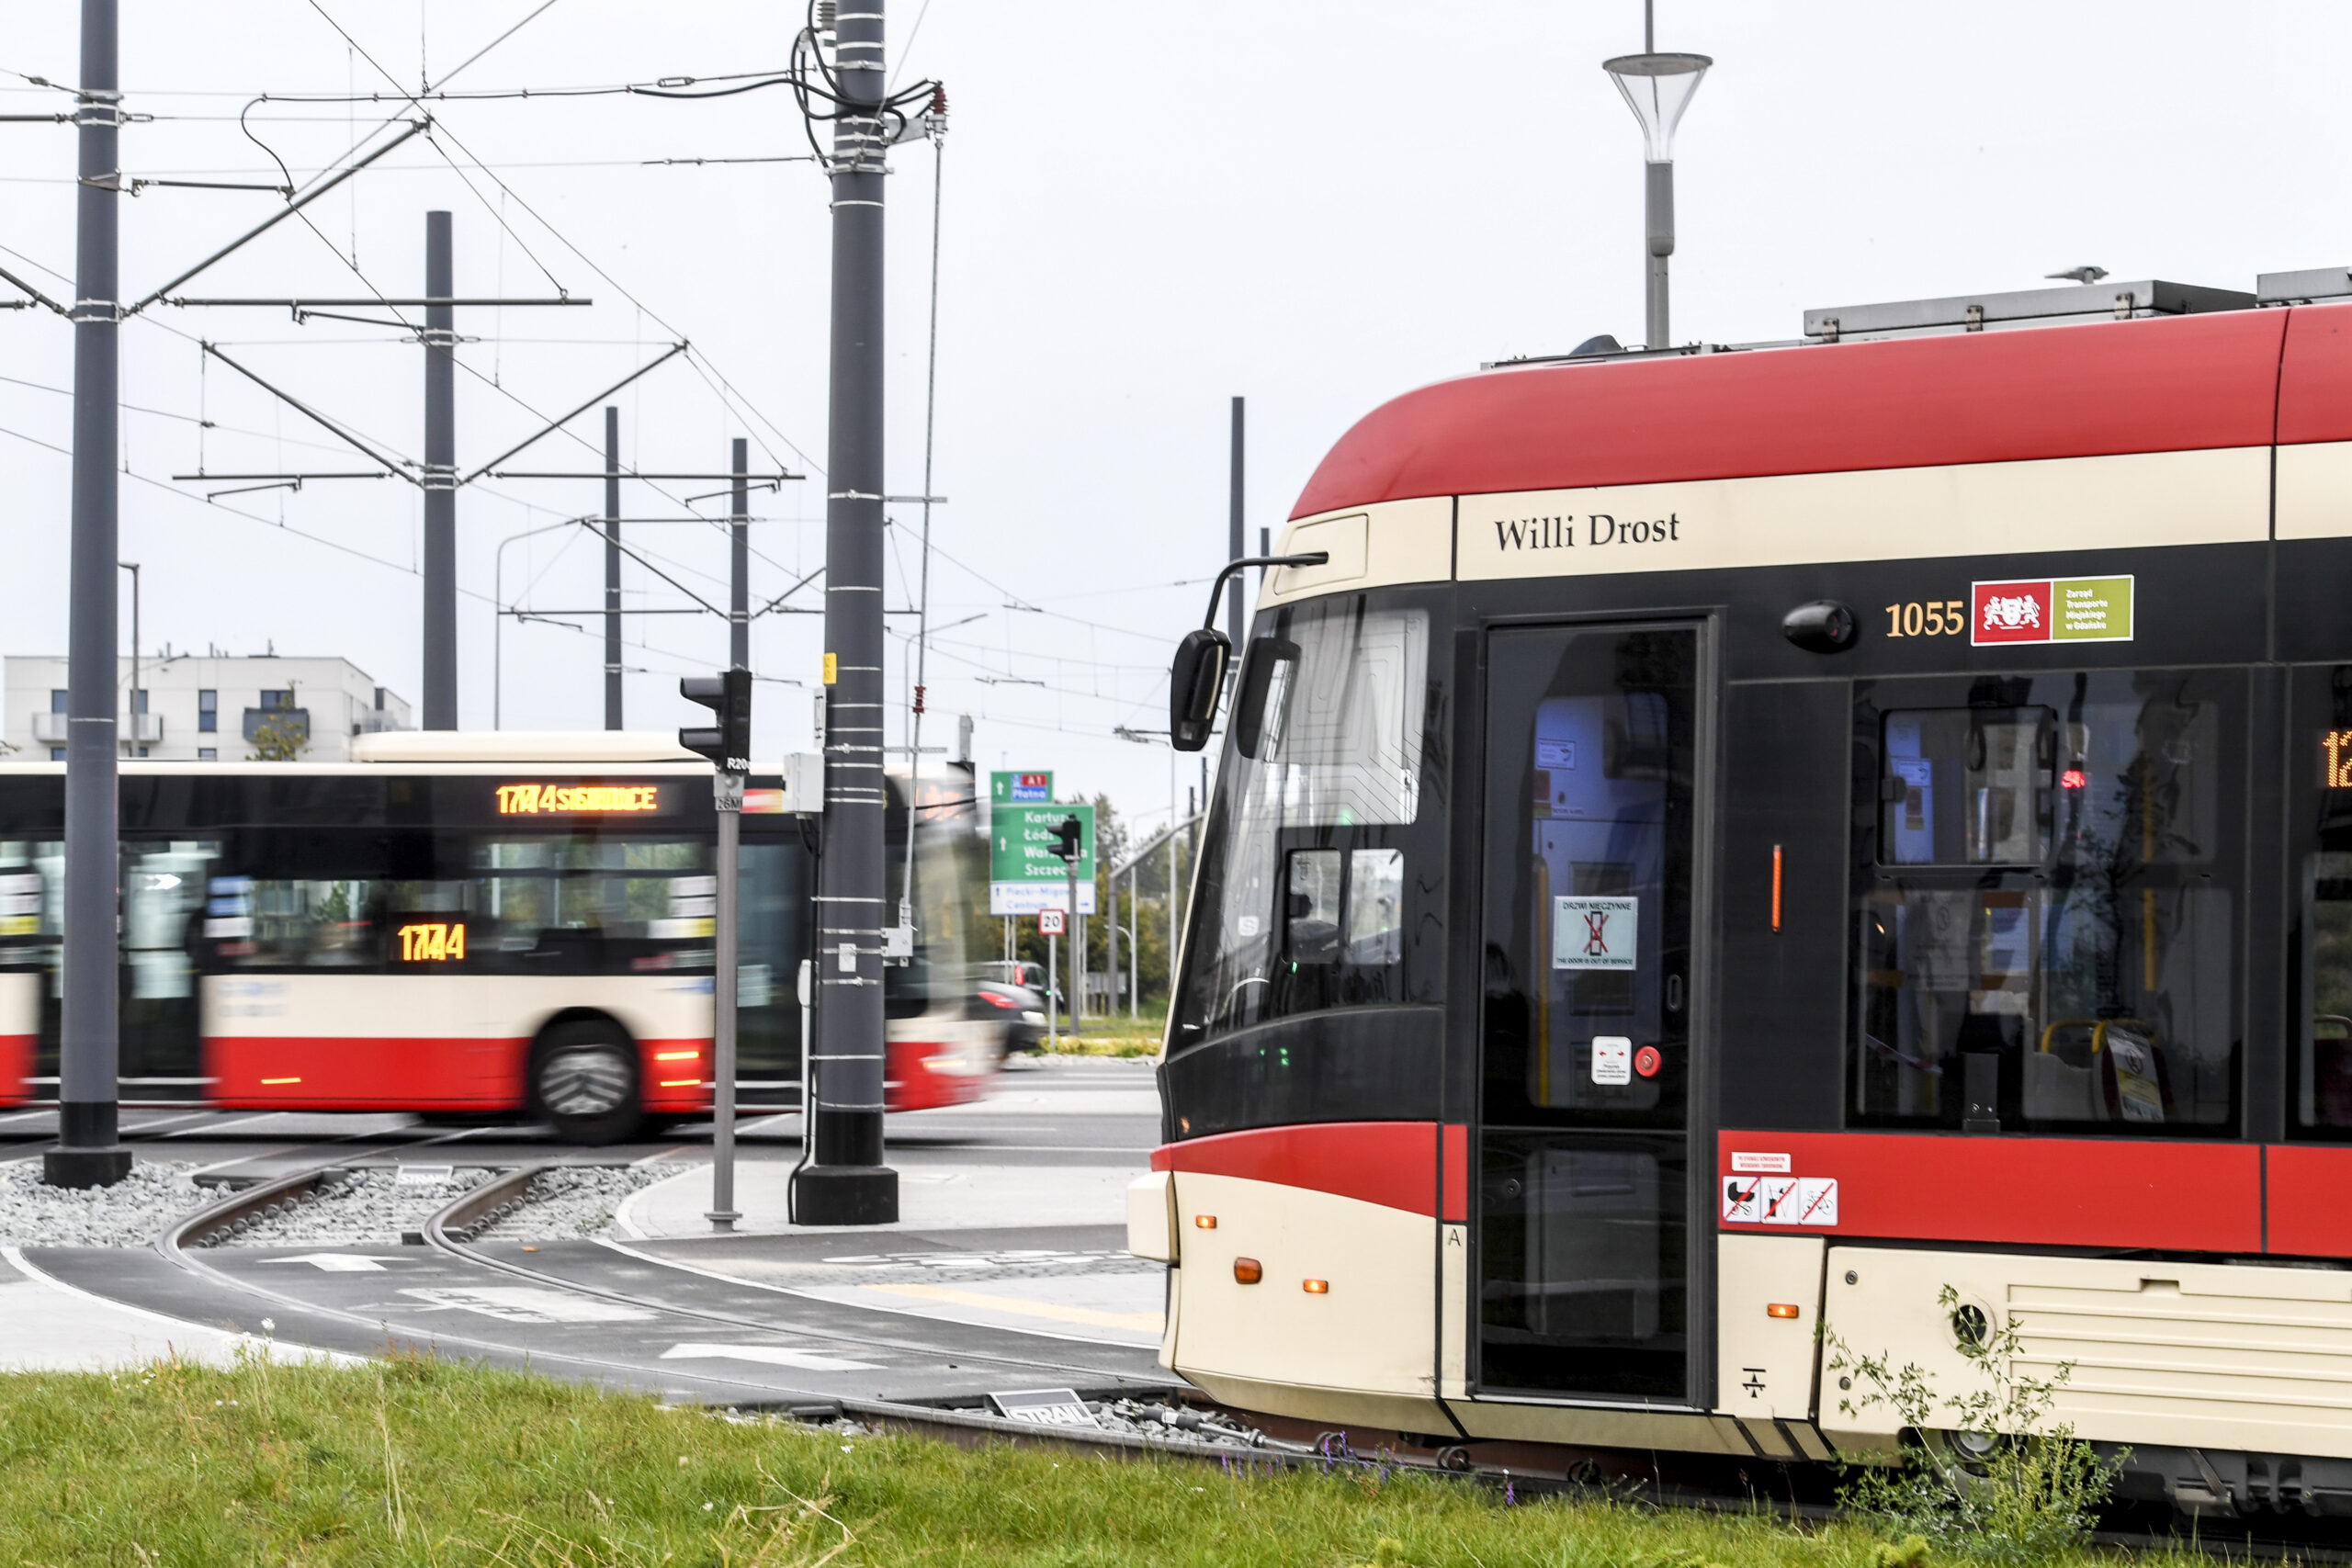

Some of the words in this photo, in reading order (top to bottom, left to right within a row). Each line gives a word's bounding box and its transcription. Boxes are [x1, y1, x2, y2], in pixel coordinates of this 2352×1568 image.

[1495, 515, 1575, 551] Willi
[1588, 513, 1680, 546] Drost
[2065, 589, 2094, 599] Zarząd
[2065, 600, 2109, 610] Transportu
[1885, 600, 1965, 637] 1055
[2065, 610, 2107, 621] Miejskiego
[2073, 620, 2107, 631] Gdańsku
[1027, 775, 1043, 785] A1
[1023, 846, 1088, 859] Wara
[1024, 863, 1069, 876] Szczec
[1563, 902, 1588, 910] DRZWI
[1589, 902, 1632, 910] NIECZYNNE
[1044, 916, 1060, 928] 20
[1448, 1228, 1461, 1247] A
[1008, 1405, 1091, 1425] STRAIL
